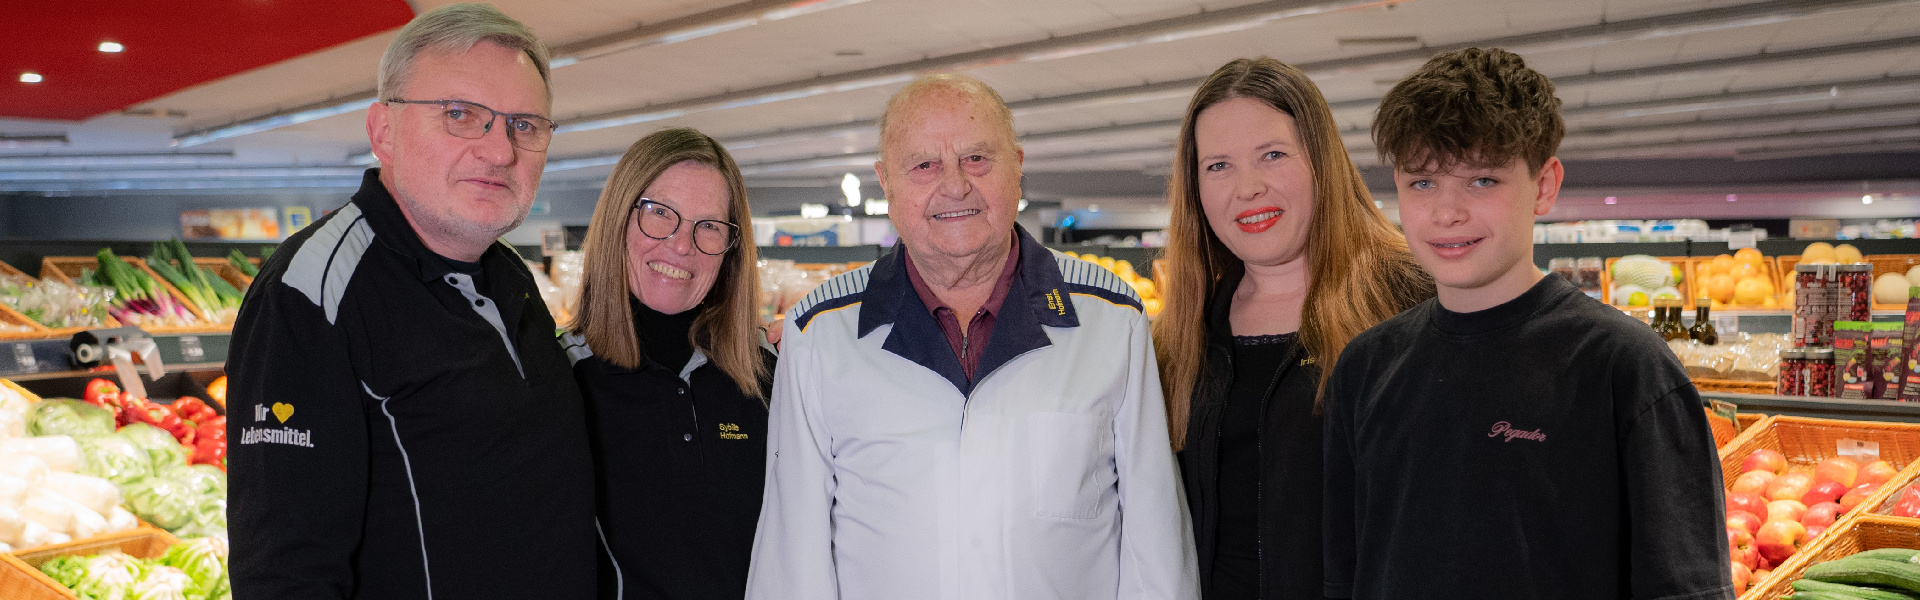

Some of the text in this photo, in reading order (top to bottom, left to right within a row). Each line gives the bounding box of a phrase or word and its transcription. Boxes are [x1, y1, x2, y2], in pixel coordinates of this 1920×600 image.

[1045, 293, 1057, 310] Ernst
[1052, 288, 1066, 316] Hofmann
[1300, 357, 1315, 367] Iris
[240, 426, 315, 448] Lebensmittel.
[720, 431, 749, 440] Hofmann
[1487, 420, 1547, 443] Pegador
